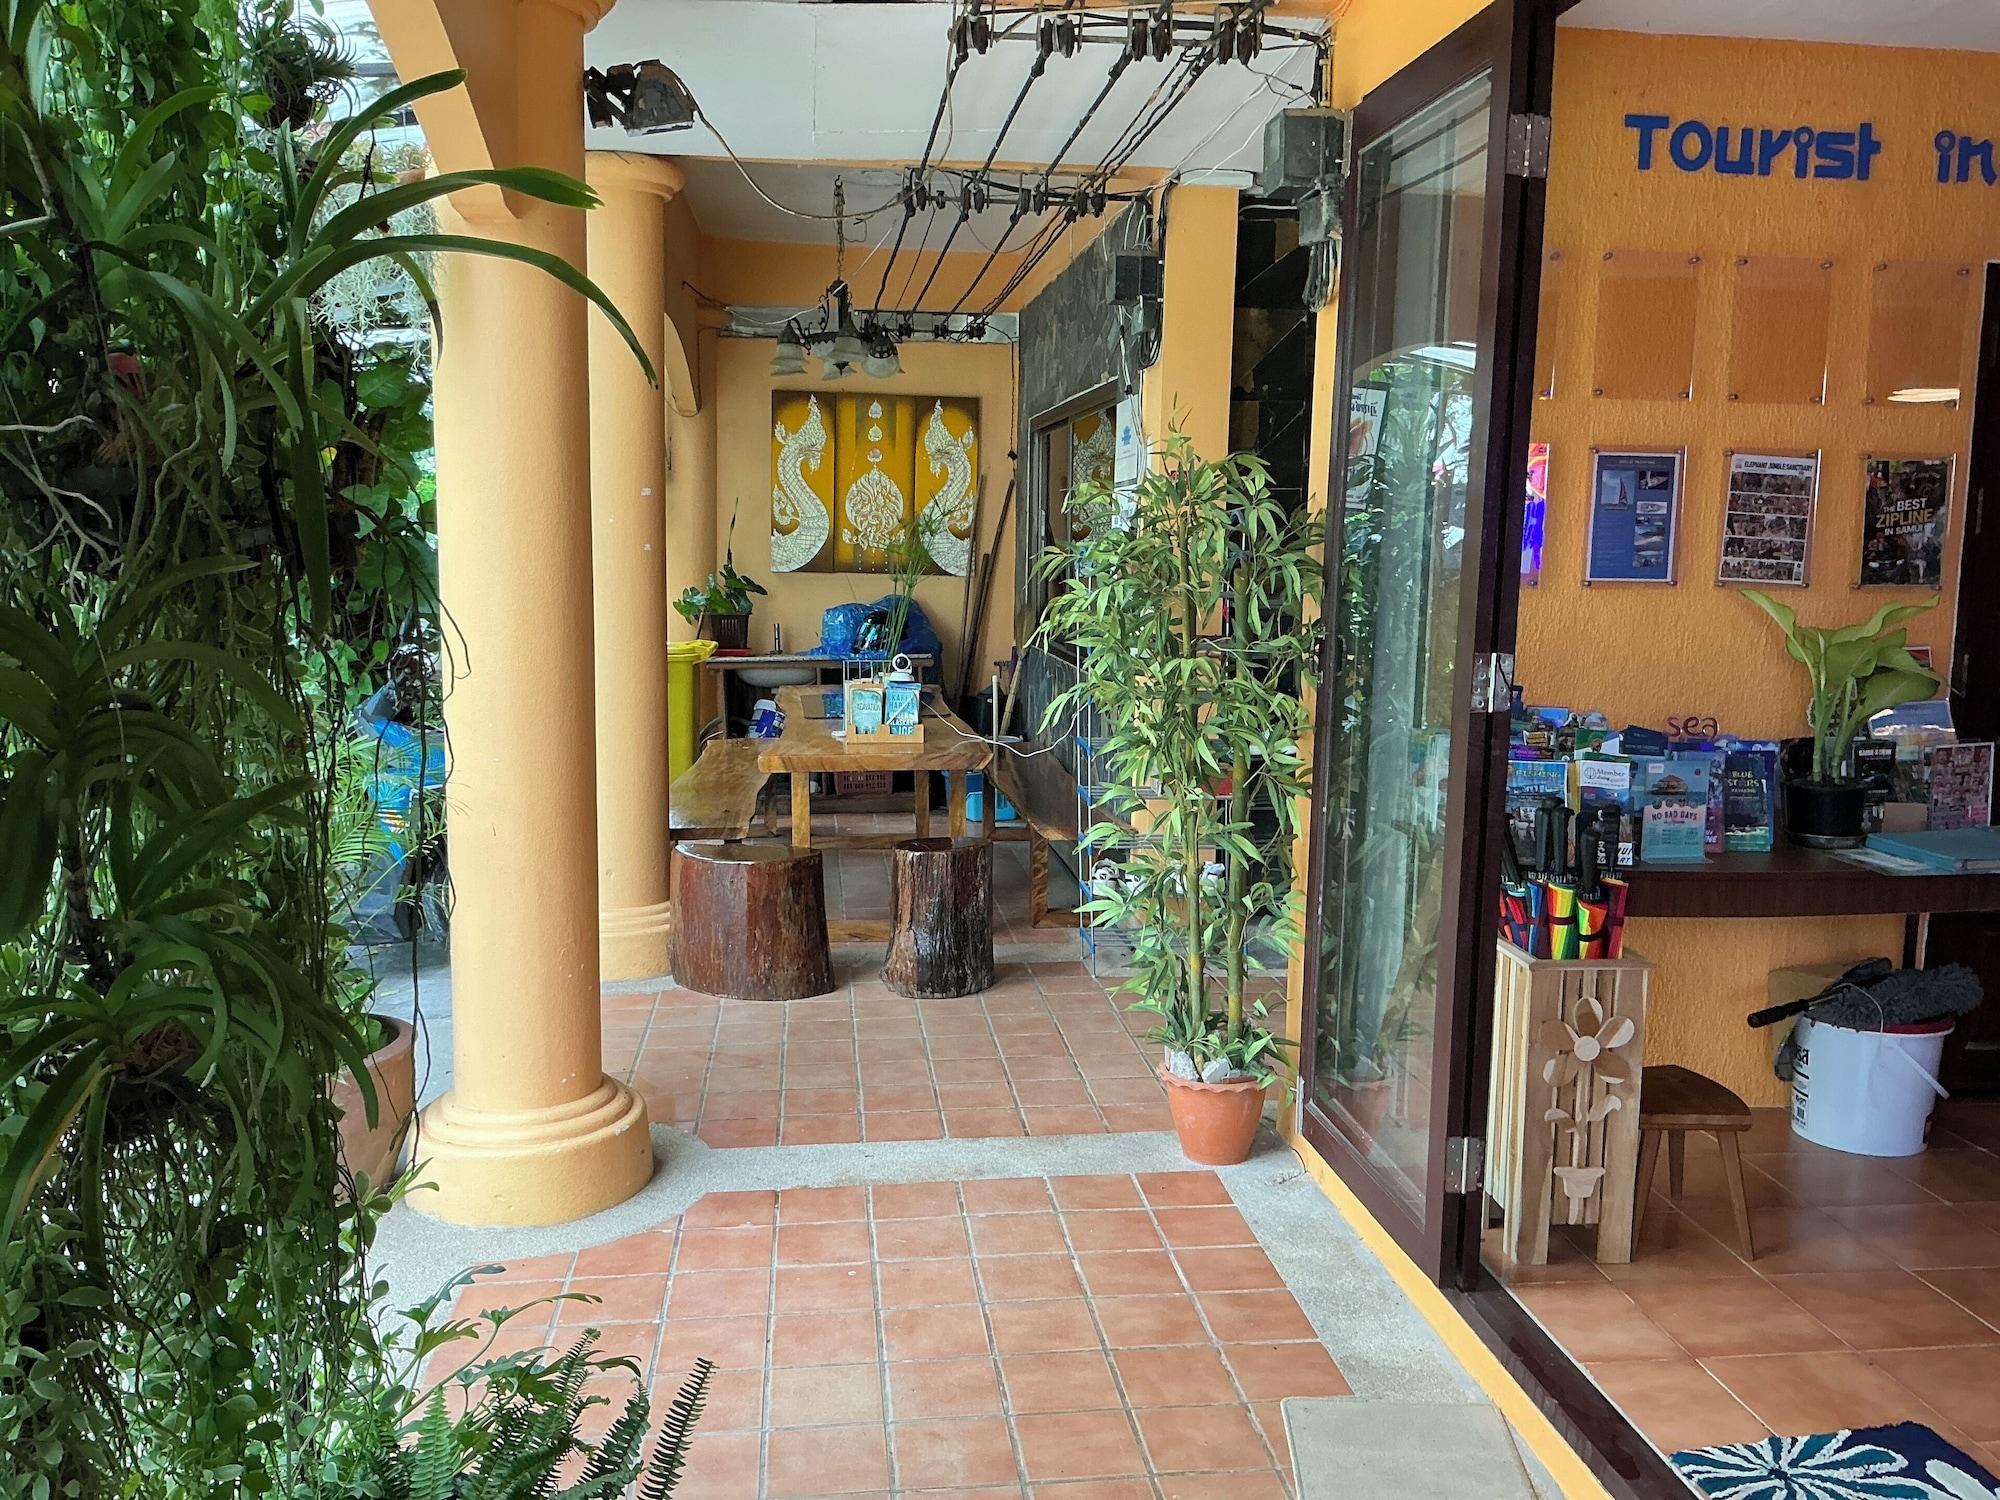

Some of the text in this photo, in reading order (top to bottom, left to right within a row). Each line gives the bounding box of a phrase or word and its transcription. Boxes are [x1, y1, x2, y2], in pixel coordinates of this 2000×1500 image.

[1744, 460, 1813, 471] ELEPHANT JUNGLE SANCTUARY
[1883, 498, 1928, 513] THE BEST
[1875, 508, 1934, 528] ZIPLINE
[1884, 524, 1924, 536] IN SAMUI
[1667, 716, 1720, 739] sea
[1596, 767, 1626, 777] Member
[1731, 770, 1754, 779] BLUE
[1651, 812, 1662, 821] NO
[1680, 811, 1698, 820] DAYS
